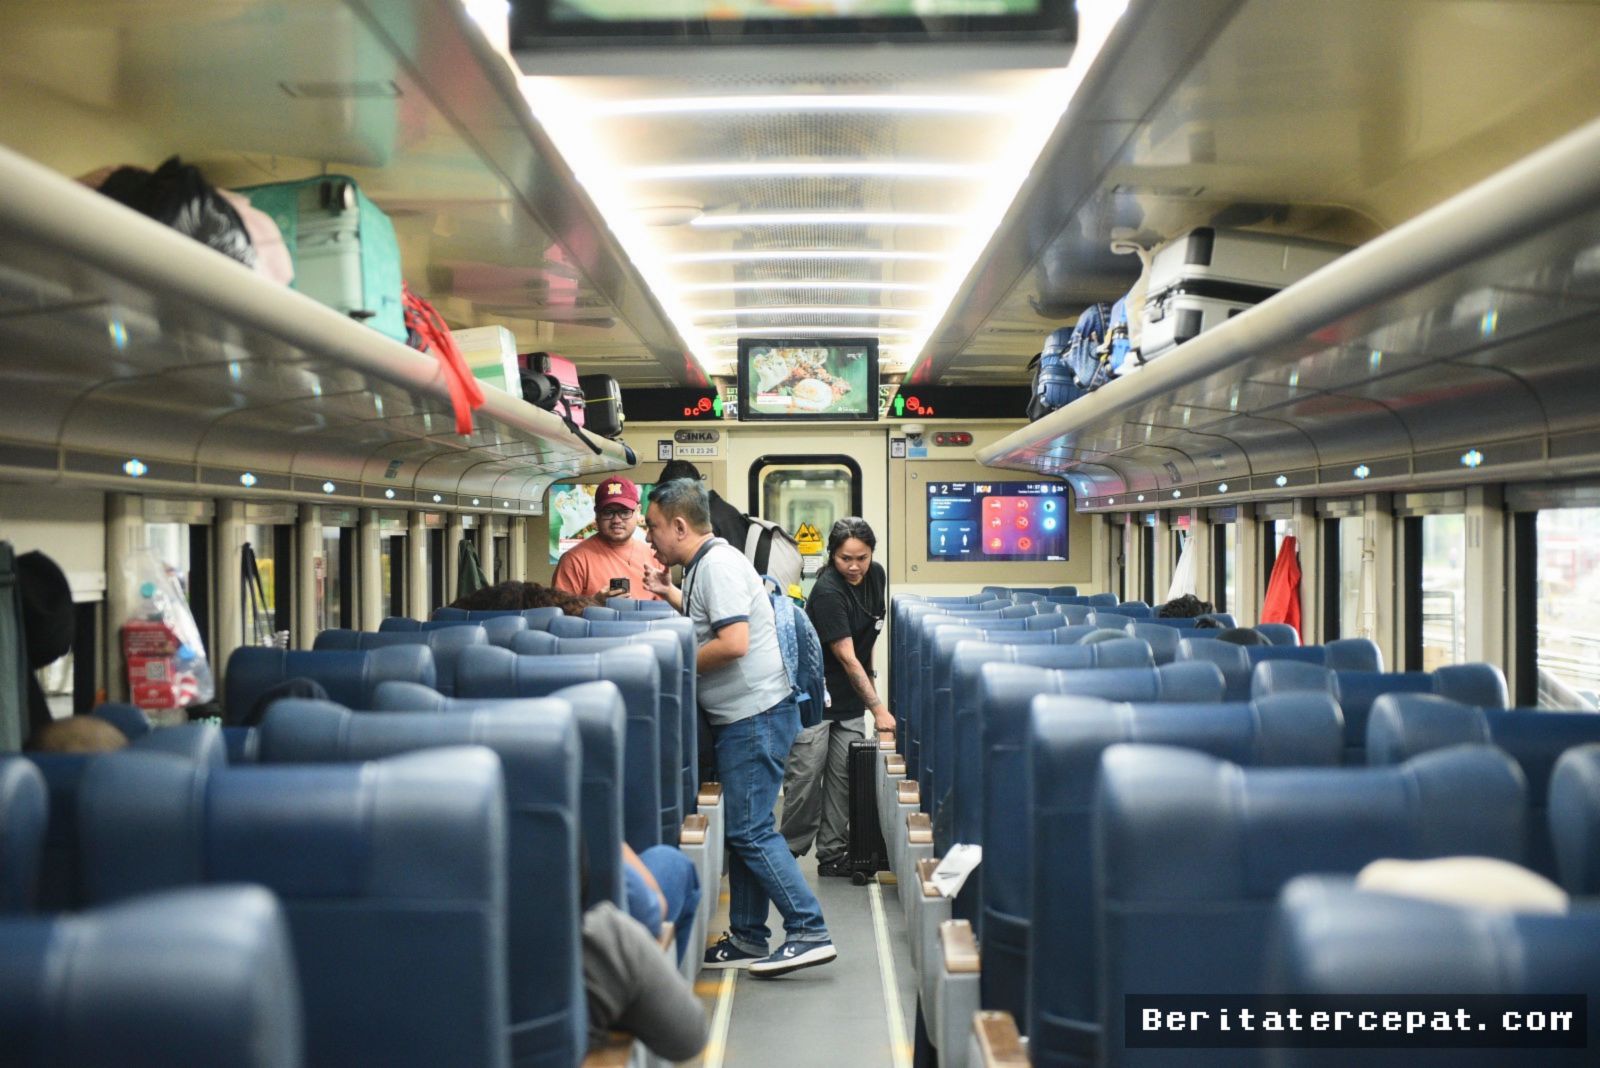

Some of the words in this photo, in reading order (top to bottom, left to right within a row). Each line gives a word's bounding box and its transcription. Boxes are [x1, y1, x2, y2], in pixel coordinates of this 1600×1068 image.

[926, 406, 934, 415] A
[688, 432, 713, 440] INKA
[941, 484, 948, 494] 2
